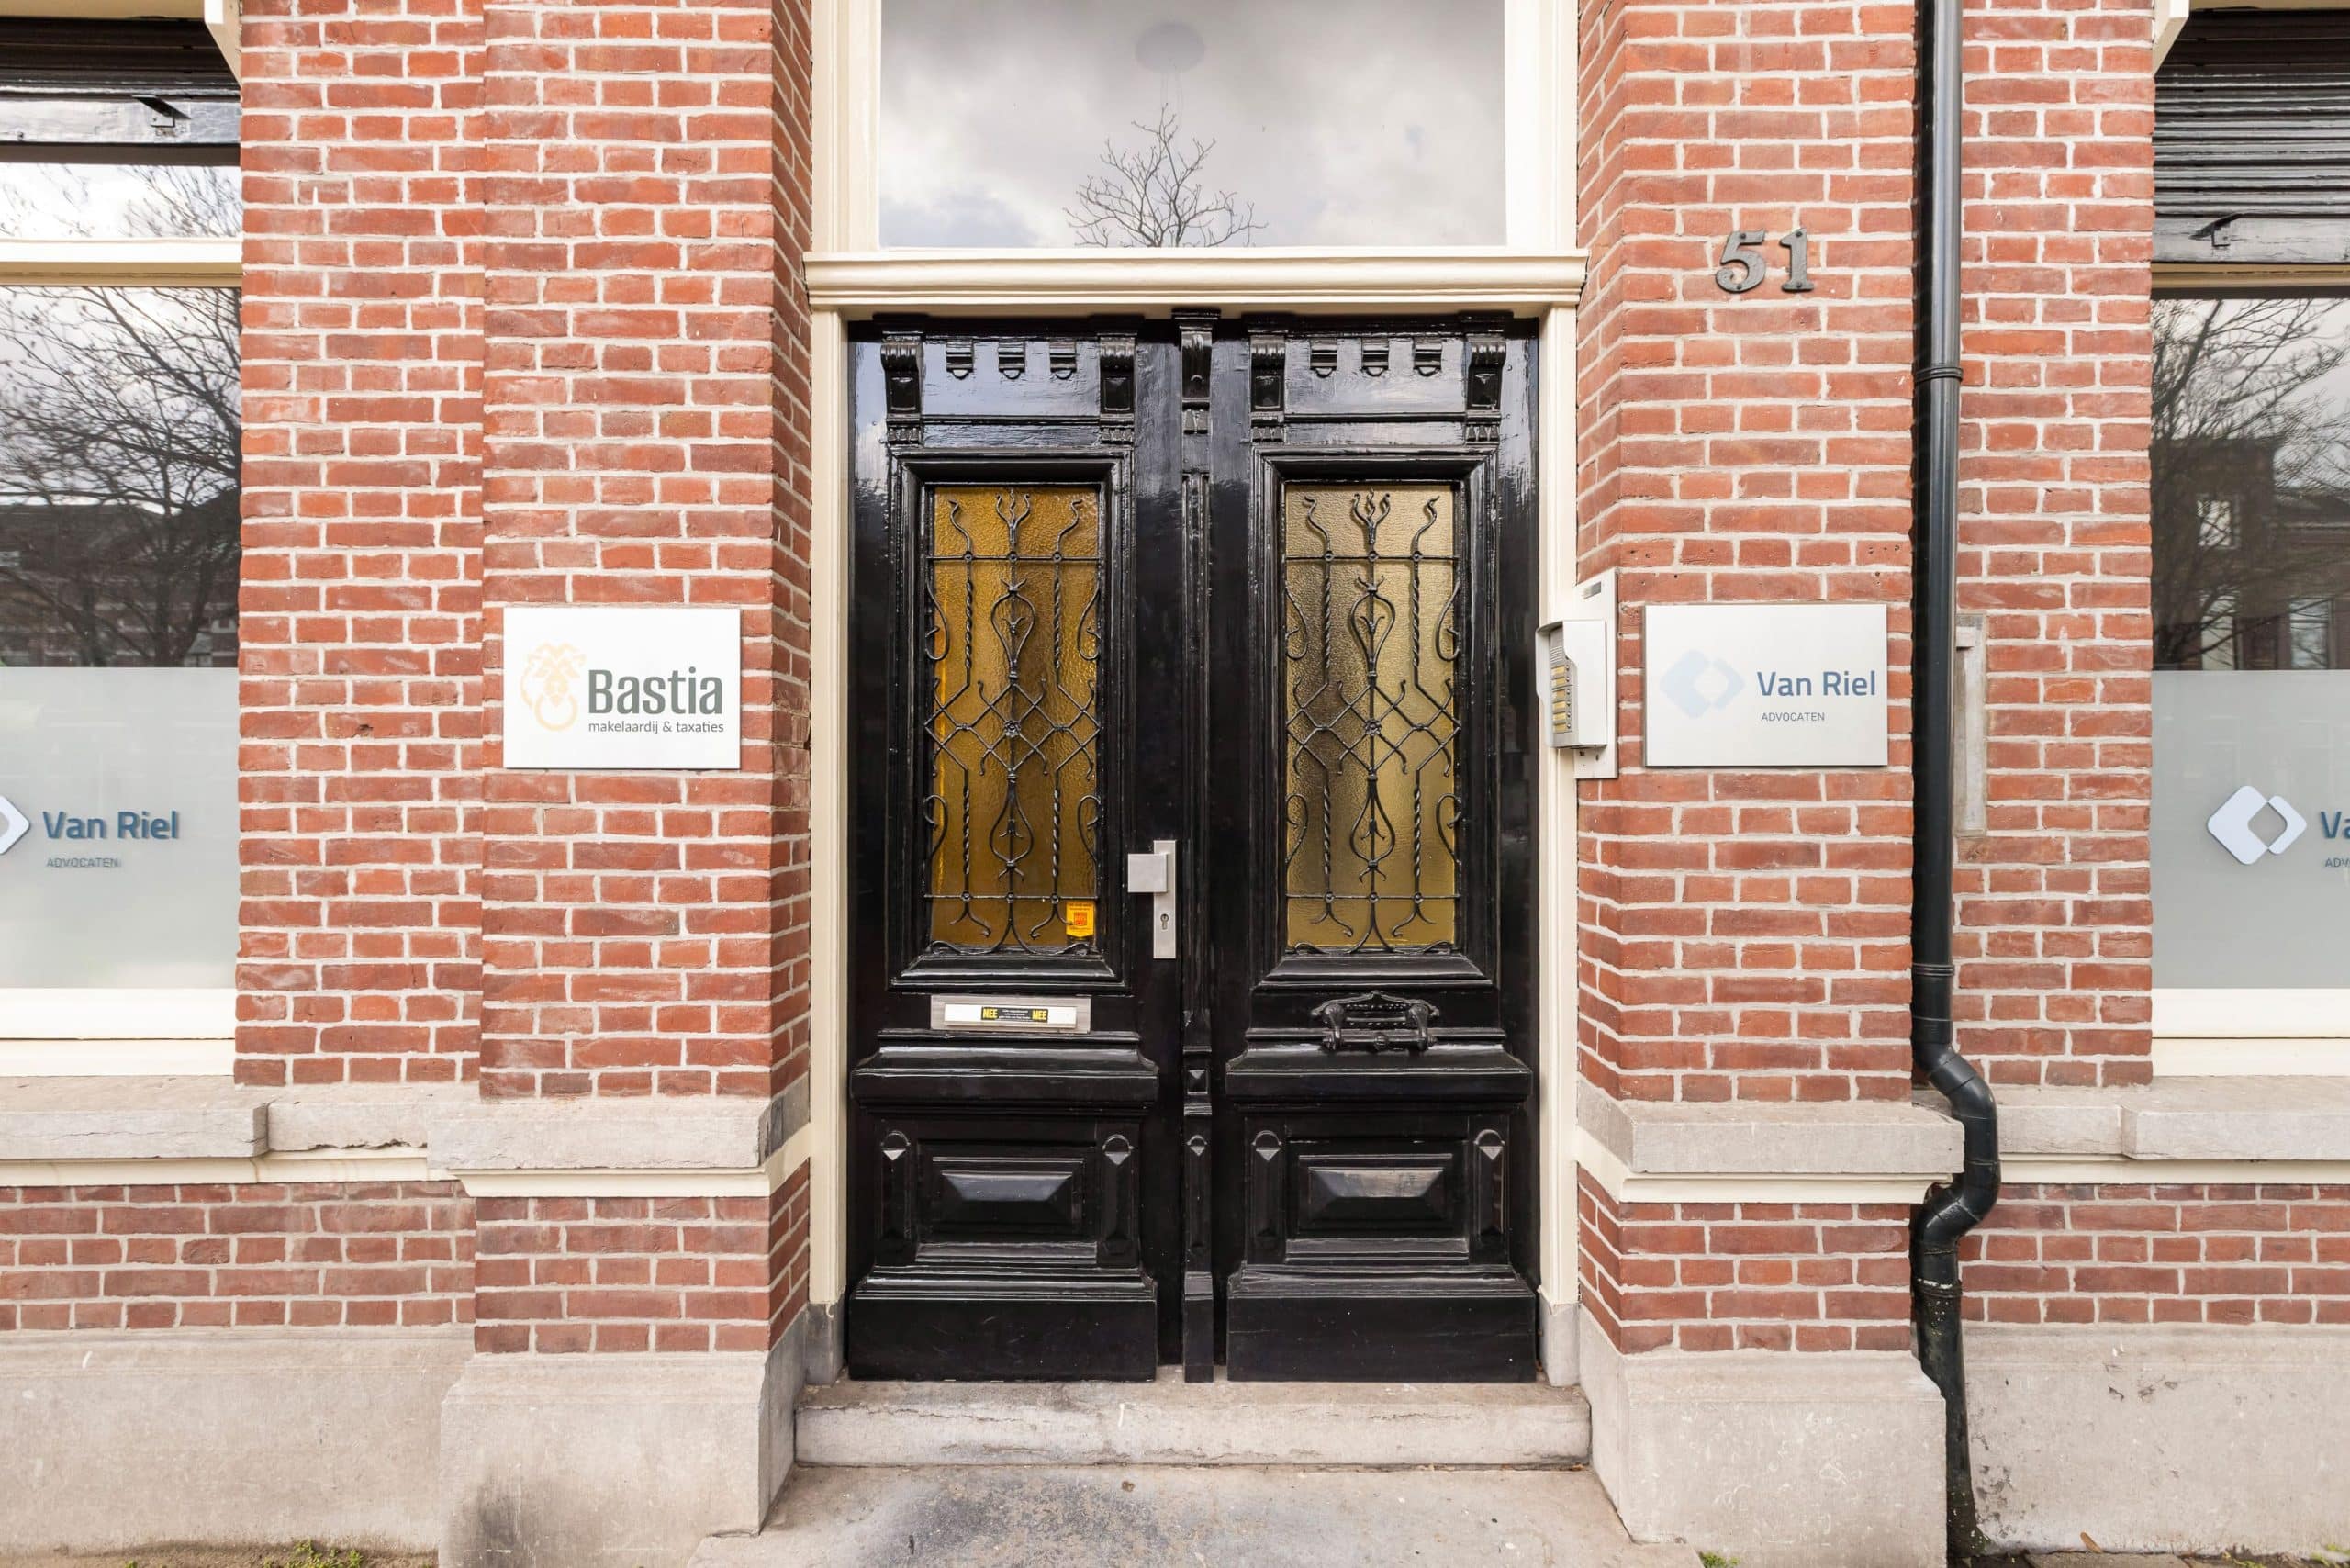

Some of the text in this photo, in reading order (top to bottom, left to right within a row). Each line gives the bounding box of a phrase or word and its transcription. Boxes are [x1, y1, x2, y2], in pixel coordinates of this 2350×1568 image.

[1716, 228, 1815, 293] 51
[1757, 670, 1875, 696] Van Riel
[588, 666, 722, 715] Bastia
[1761, 712, 1826, 722] ADVOCATEN
[588, 721, 724, 734] makelaardij & taxaties
[42, 810, 179, 839] Van Riel
[47, 857, 118, 868] ADVOCATEN
[983, 1008, 998, 1019] NEE
[1032, 1010, 1047, 1021] NEE
